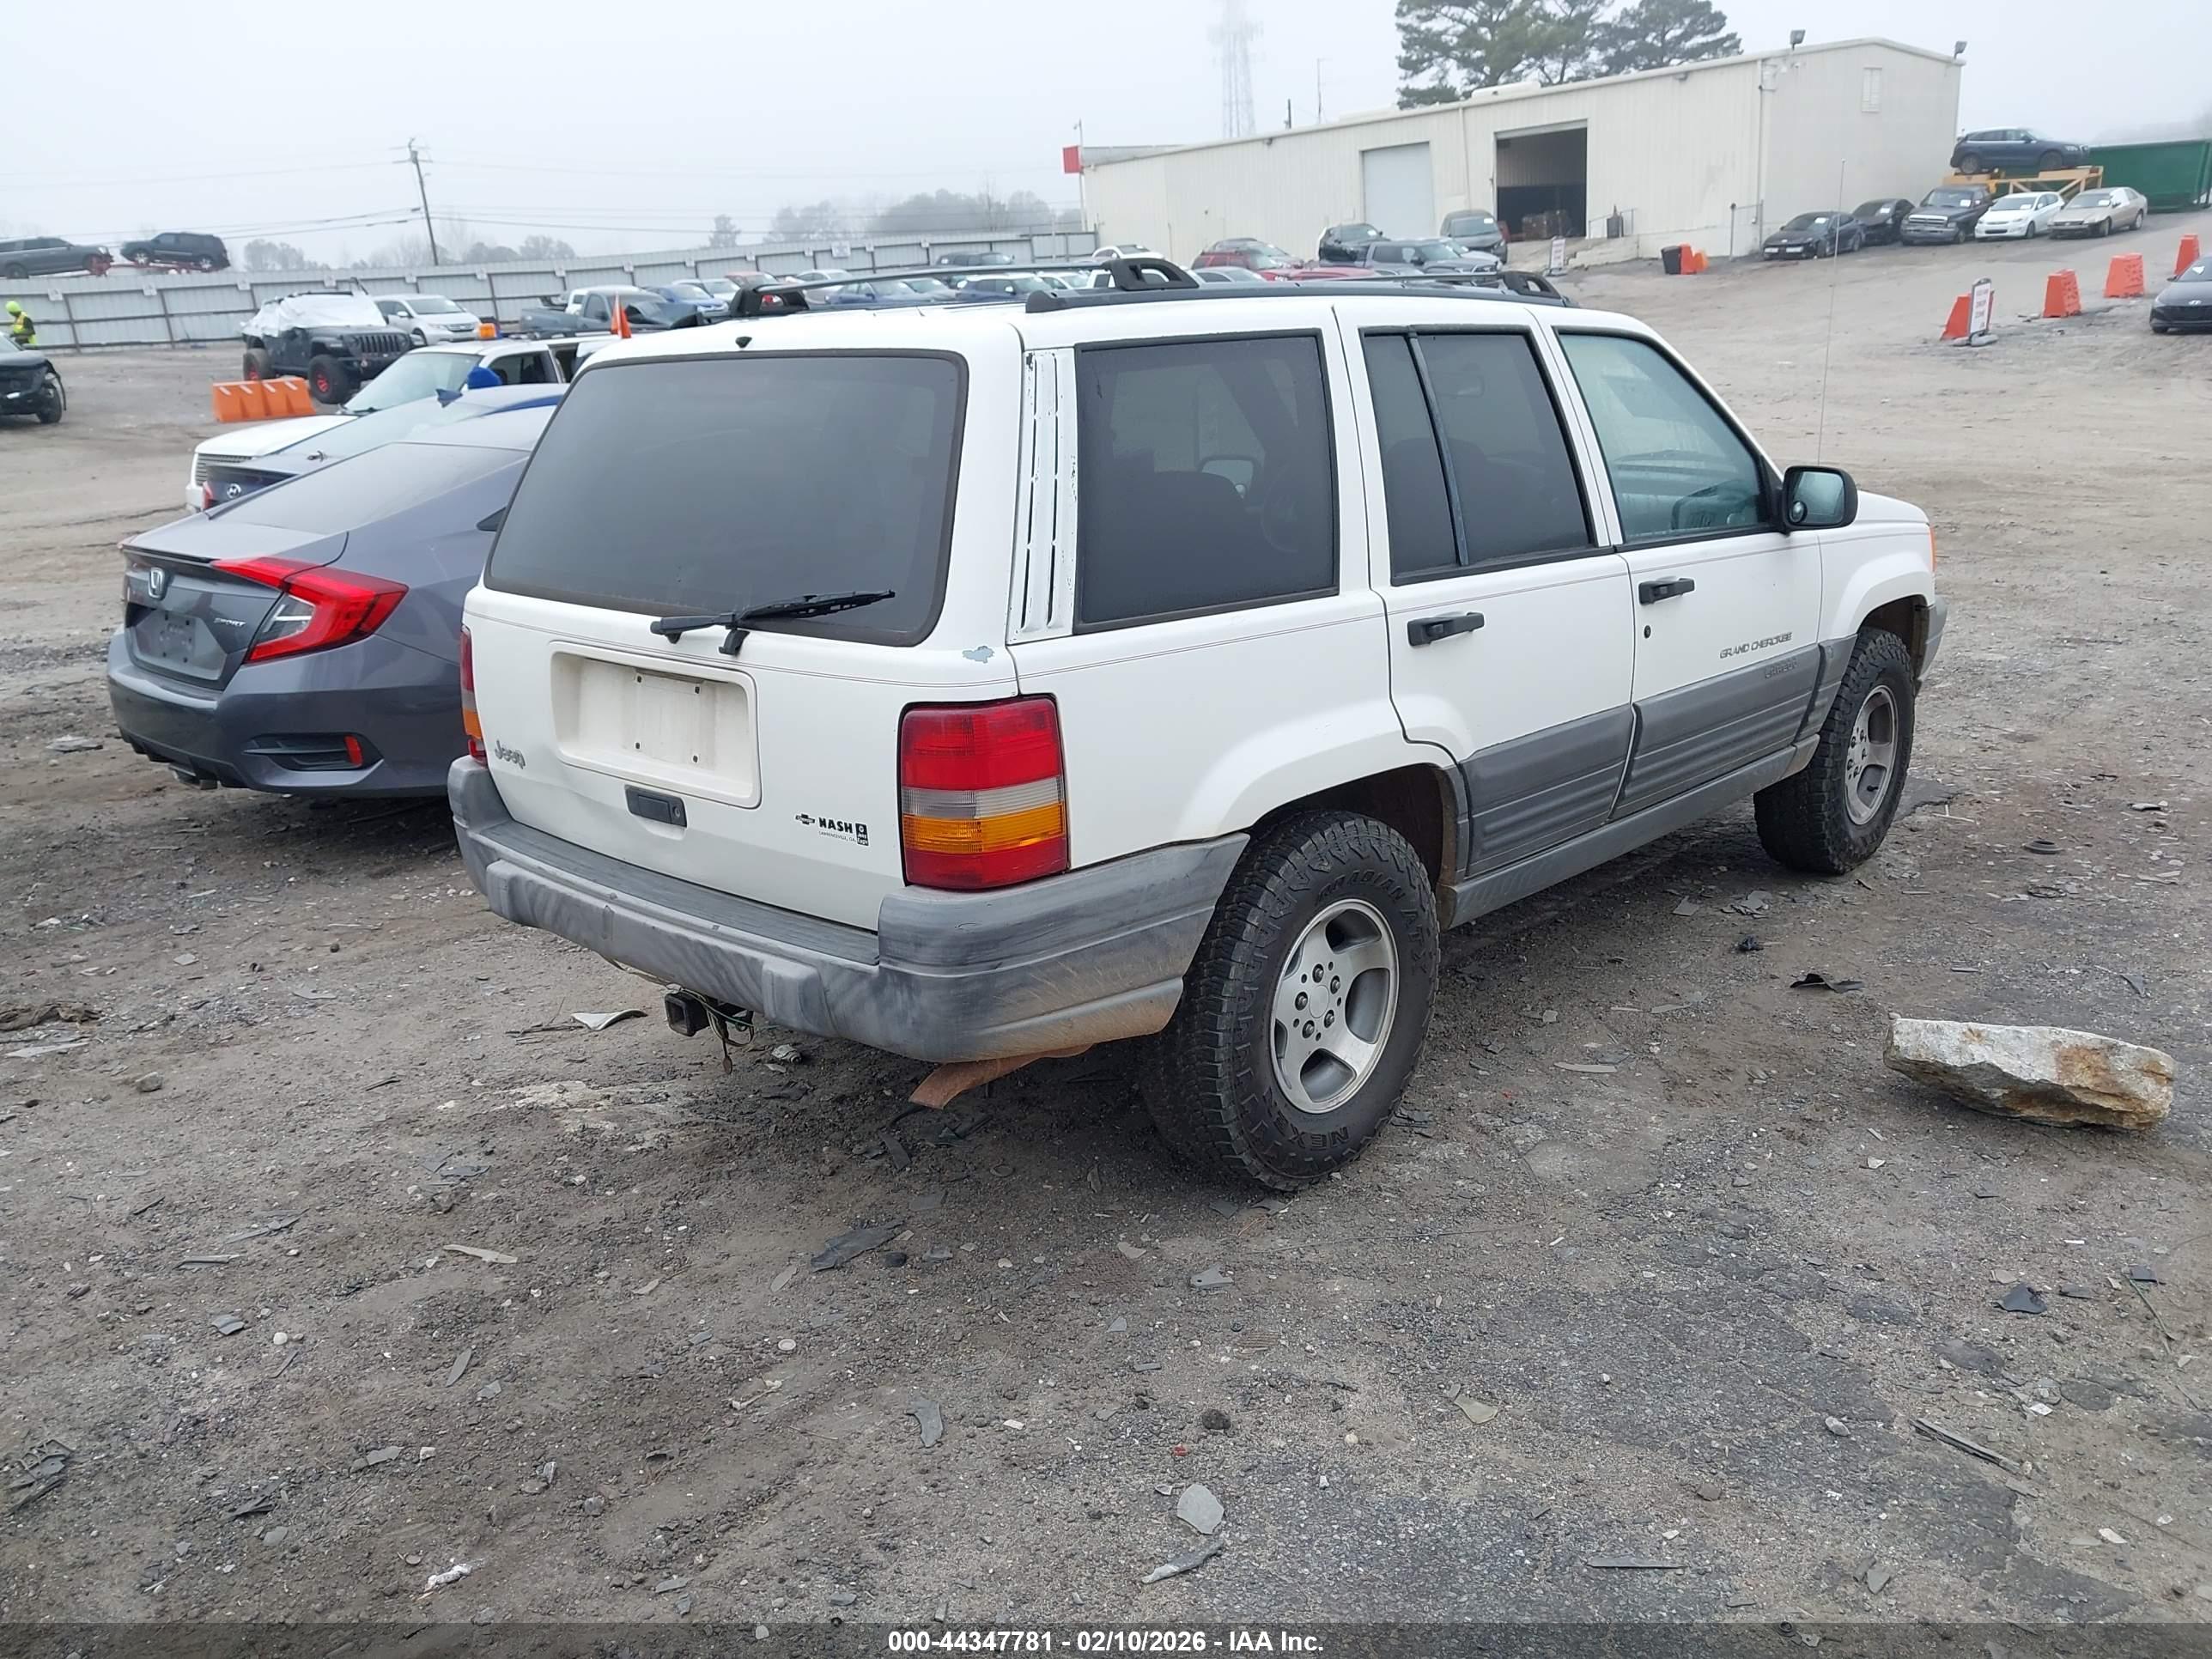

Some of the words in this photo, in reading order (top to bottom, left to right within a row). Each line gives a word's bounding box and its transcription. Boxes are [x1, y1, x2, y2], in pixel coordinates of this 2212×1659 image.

[213, 617, 246, 627] SPORT
[1719, 642, 1750, 659] GRAND
[1751, 632, 1793, 651] CHEROKEE
[494, 739, 526, 770] Jeep
[818, 817, 854, 834] NASH
